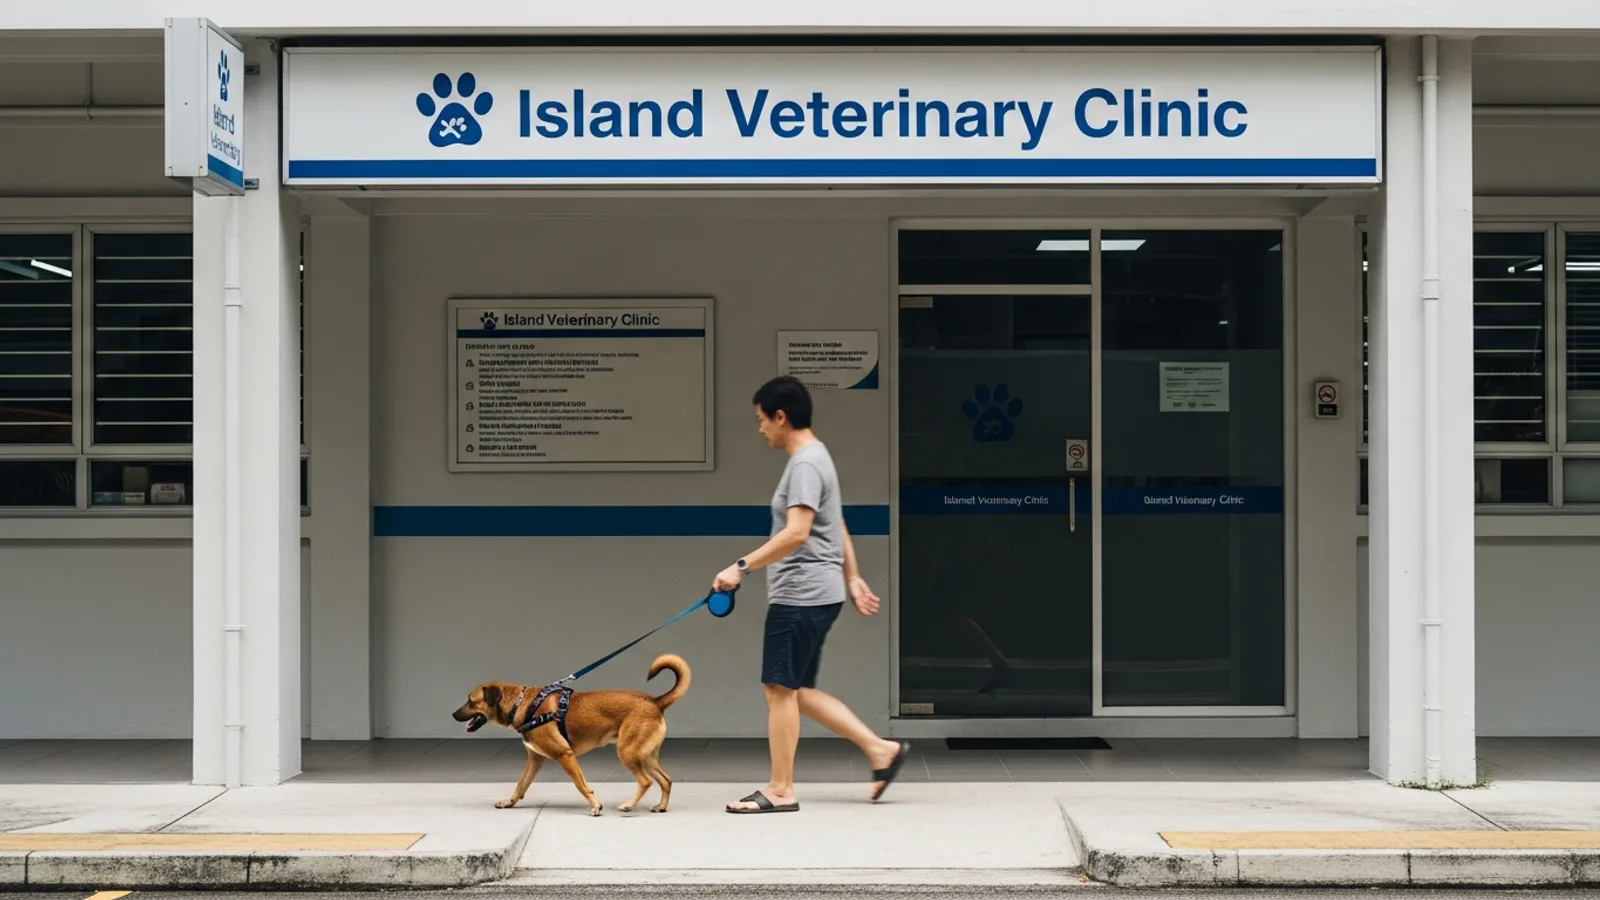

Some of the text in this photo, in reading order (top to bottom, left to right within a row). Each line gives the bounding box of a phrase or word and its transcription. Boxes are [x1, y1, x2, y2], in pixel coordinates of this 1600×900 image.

[519, 87, 1248, 151] Island Veterinary Clinic
[504, 313, 544, 326] Island
[621, 313, 660, 326] Clinic
